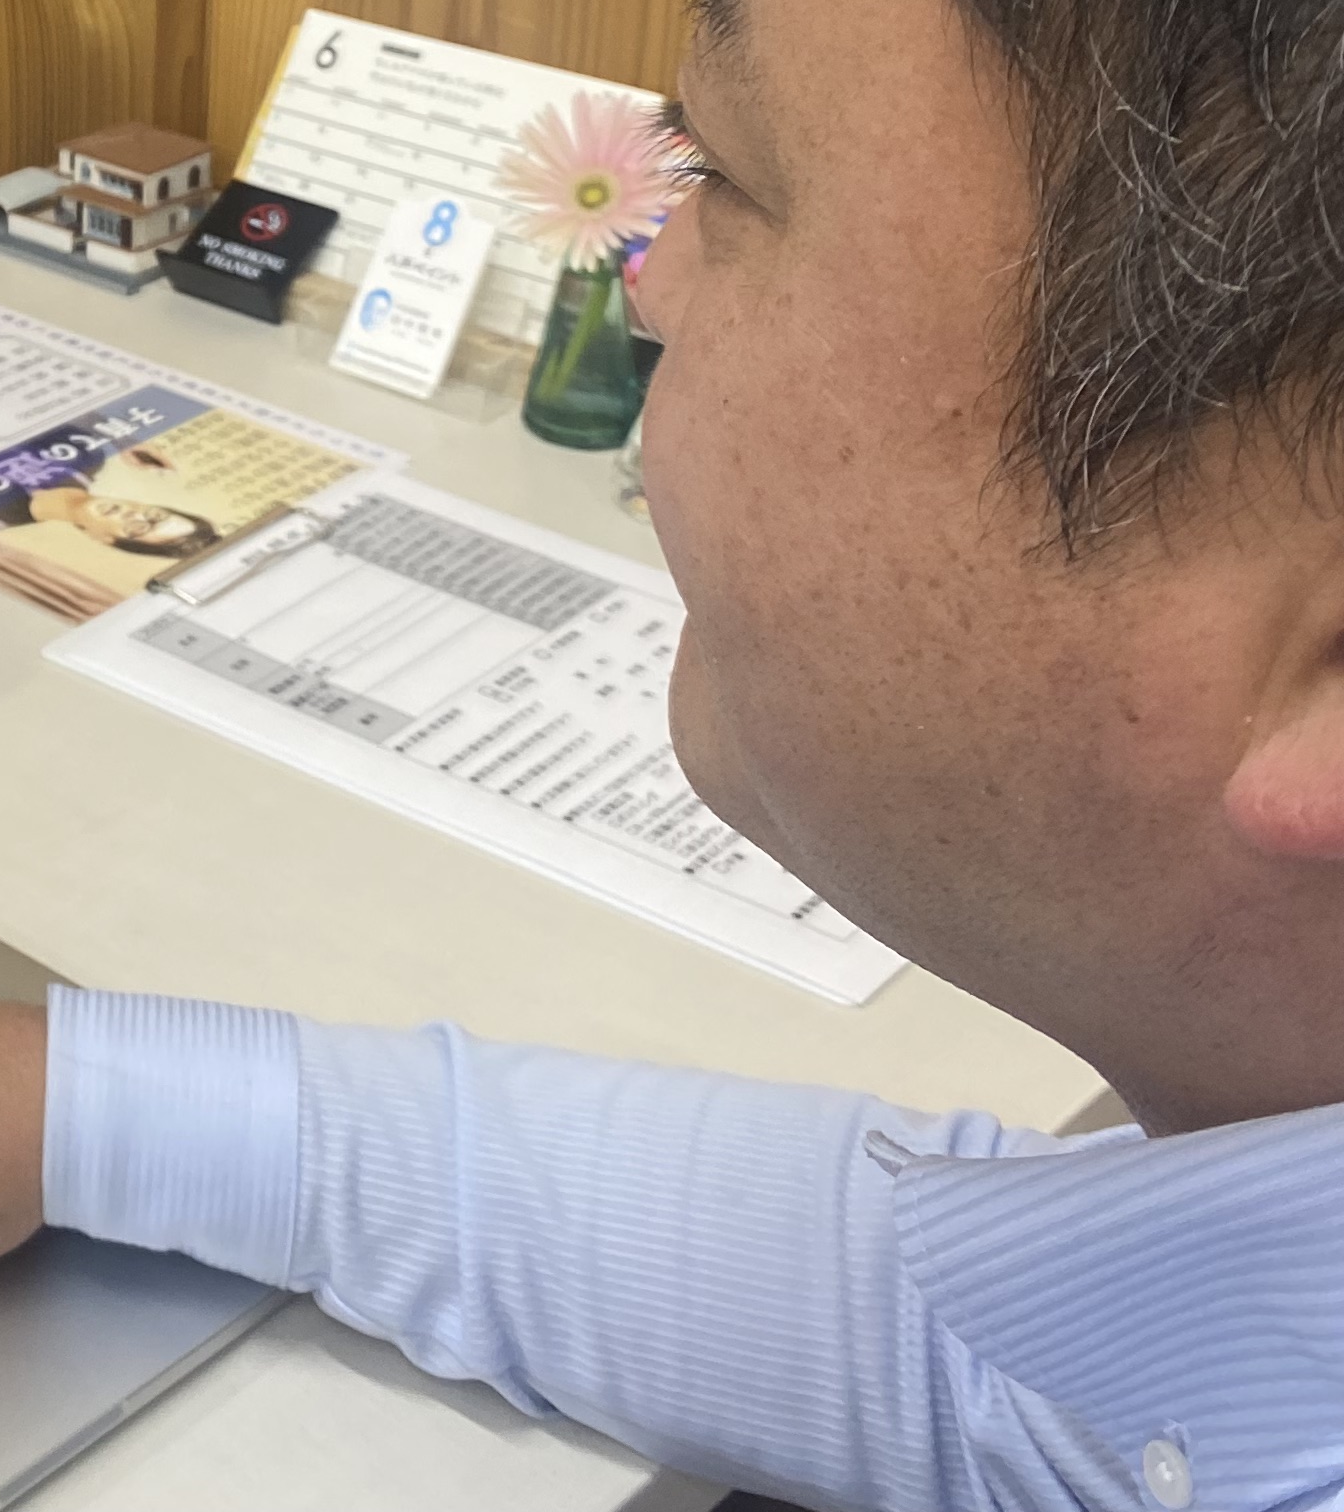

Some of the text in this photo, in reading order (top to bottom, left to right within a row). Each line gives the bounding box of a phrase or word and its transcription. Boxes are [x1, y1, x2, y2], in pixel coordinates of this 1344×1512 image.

[315, 29, 342, 69] 6
[197, 233, 289, 272] NO SMOKING
